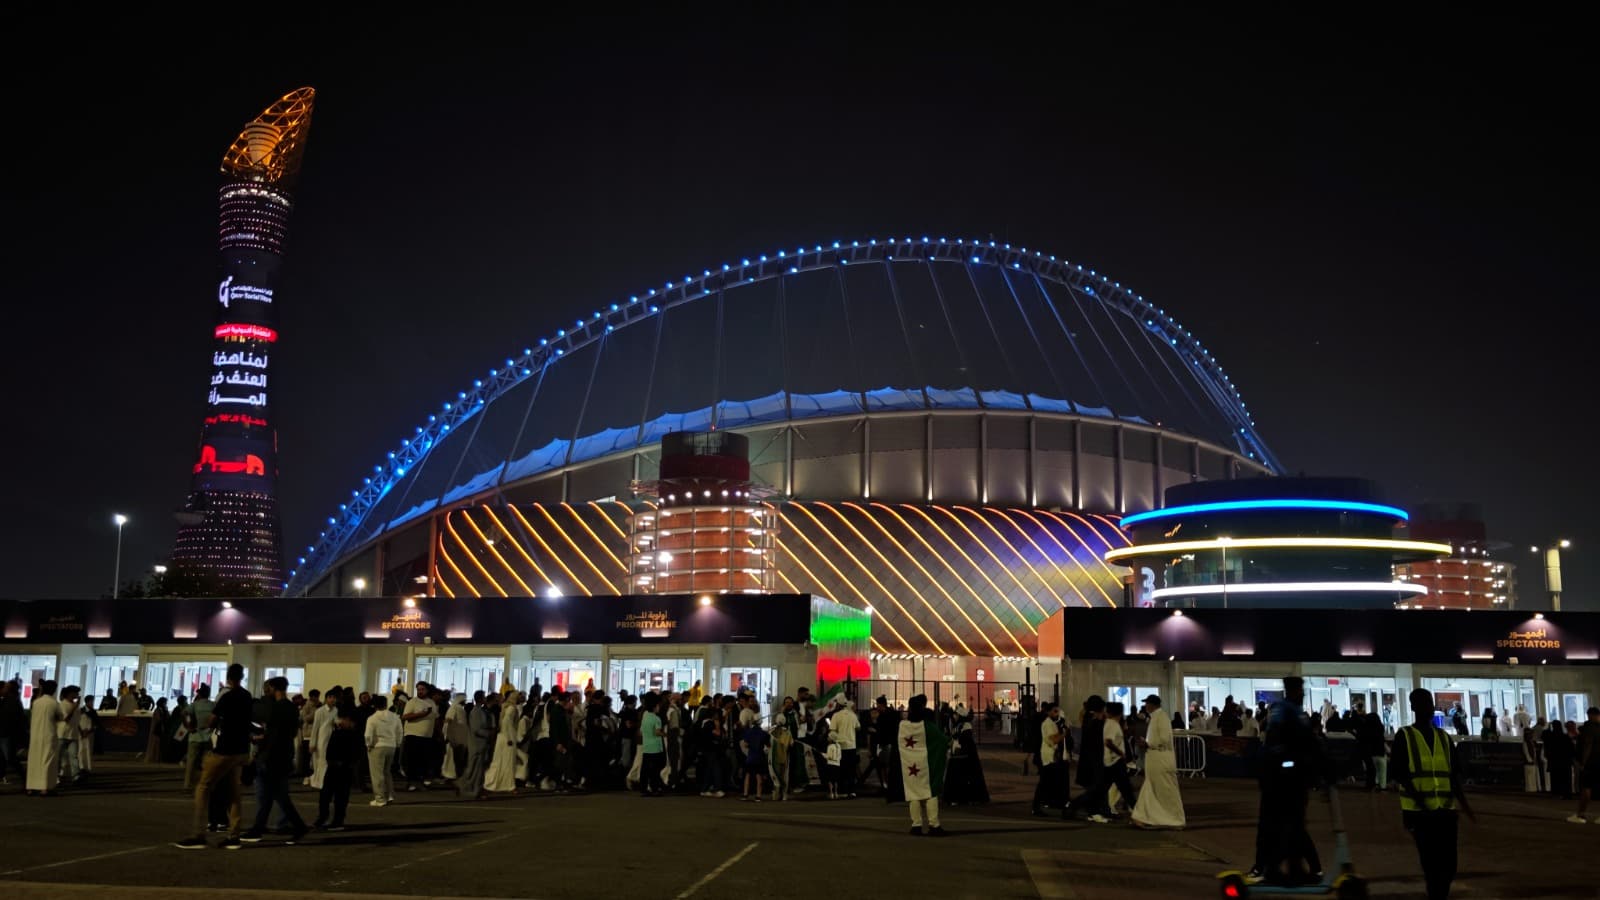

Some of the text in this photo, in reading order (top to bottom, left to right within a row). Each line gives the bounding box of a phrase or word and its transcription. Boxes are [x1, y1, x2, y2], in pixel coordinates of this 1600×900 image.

[226, 370, 267, 388] العنف
[381, 621, 431, 630] SPECTATORS
[616, 620, 677, 629] PRIORITY LANE
[1496, 639, 1561, 649] SPECTATORS
